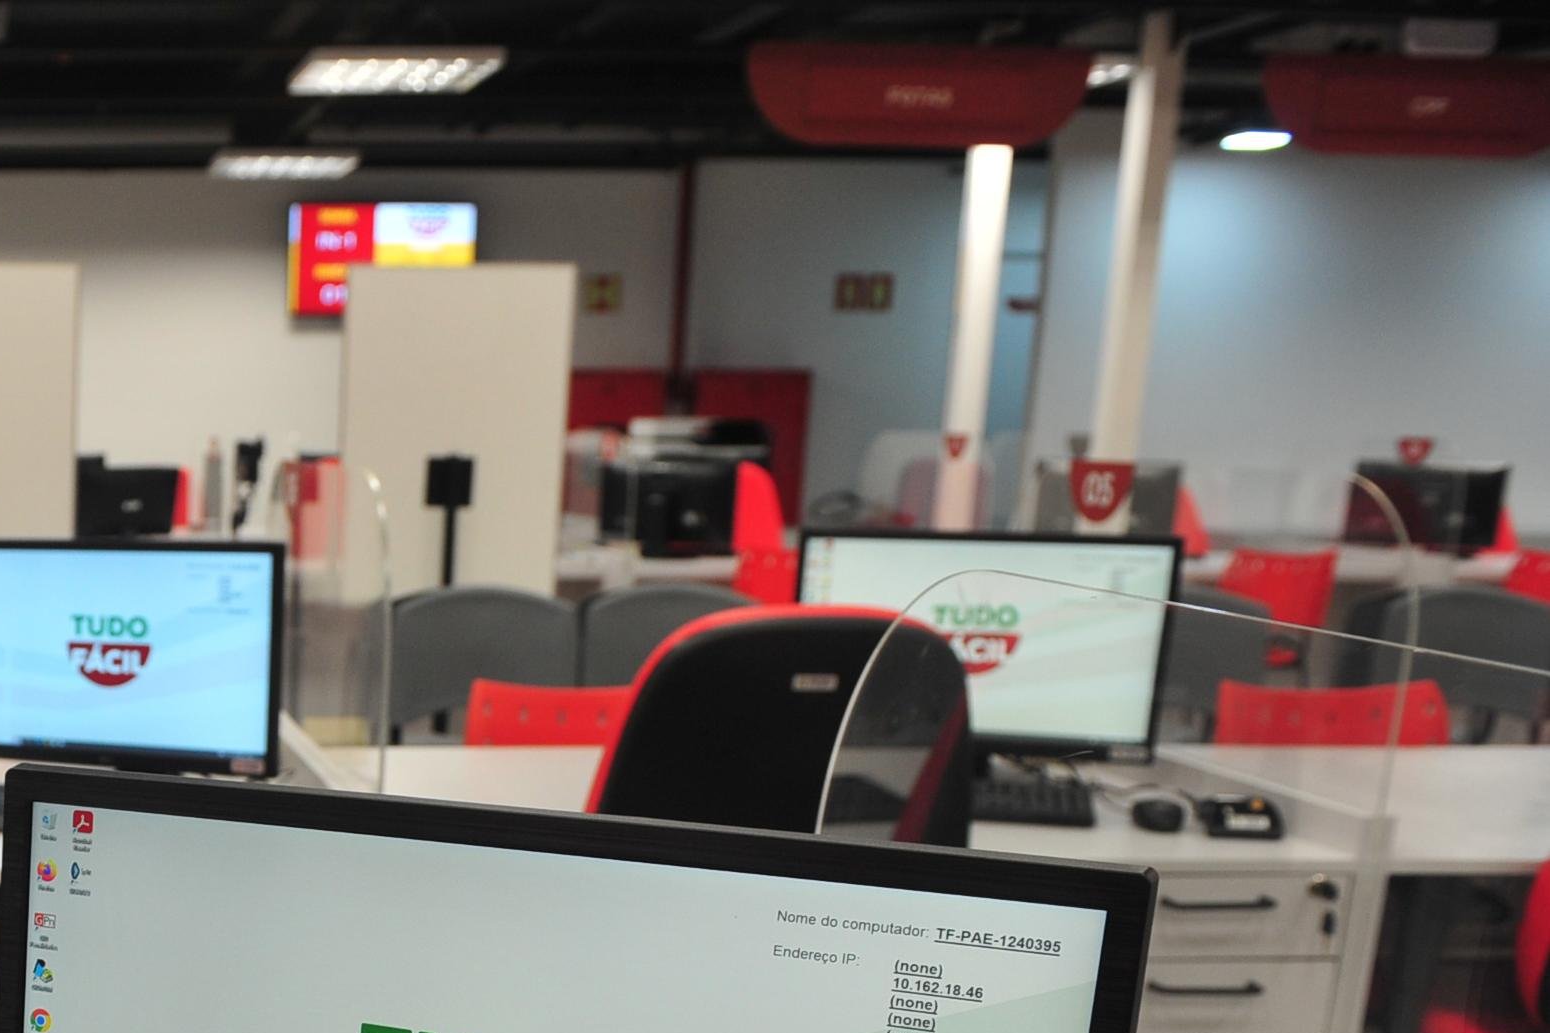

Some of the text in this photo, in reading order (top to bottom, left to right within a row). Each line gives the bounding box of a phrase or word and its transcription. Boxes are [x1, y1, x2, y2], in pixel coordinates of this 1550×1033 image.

[1081, 471, 1114, 506] 05
[72, 615, 148, 637] TUDO
[933, 604, 1020, 627] TUDO
[70, 643, 143, 675] FÁCIL
[777, 910, 1061, 954] Nome do computador: TF-PAE-1240395
[773, 945, 837, 964] Endereço
[894, 960, 943, 977] (none)
[893, 978, 983, 1000] 10.162.18.46
[890, 995, 938, 1014] (none)
[888, 1013, 936, 1031] (none)
